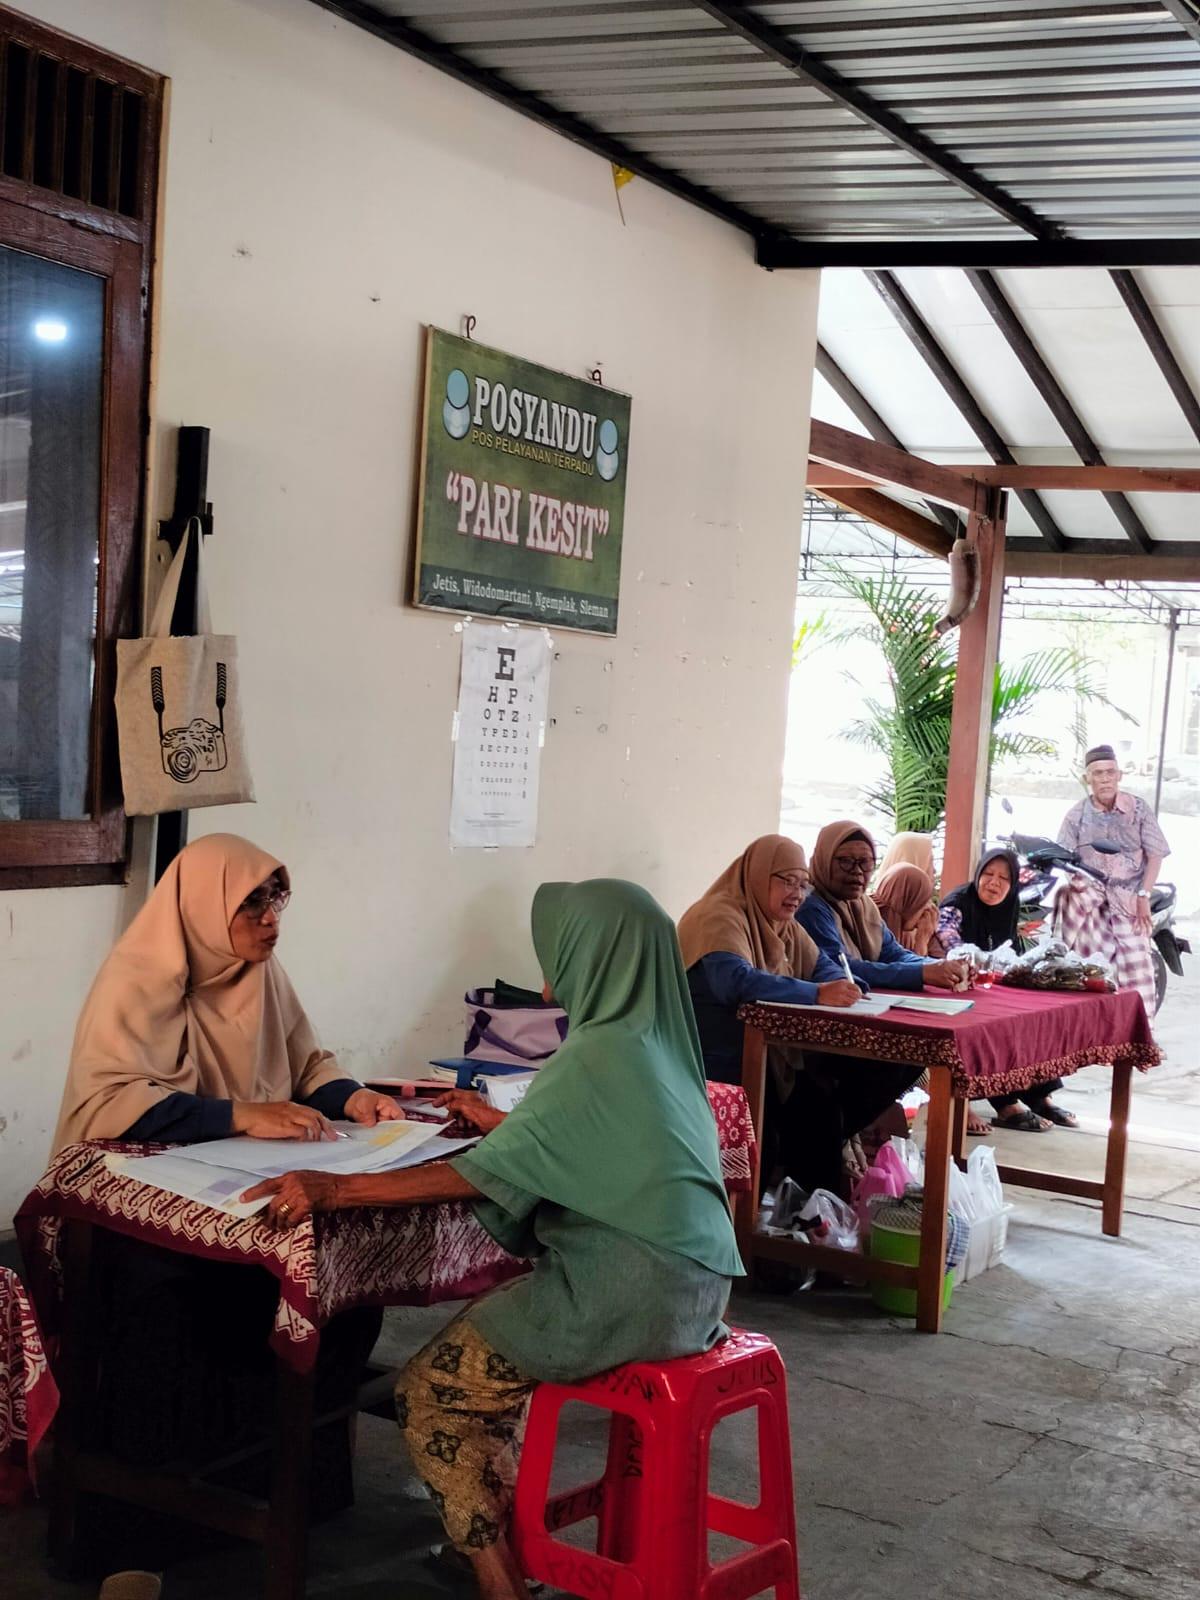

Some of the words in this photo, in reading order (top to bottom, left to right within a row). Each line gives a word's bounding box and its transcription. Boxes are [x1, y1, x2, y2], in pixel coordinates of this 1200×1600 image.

[472, 376, 597, 459] POSYANDU
[472, 429, 493, 449] POS
[495, 433, 551, 464] PELAYANAN
[553, 453, 594, 477] TERPADU
[446, 471, 521, 545] “PARI
[525, 492, 610, 562] KESIT”
[432, 573, 460, 596] Jetis,
[463, 578, 533, 607] Widodomartani,
[535, 591, 578, 615] Ngemplak,
[580, 598, 608, 618] Sleman
[495, 646, 516, 681] E
